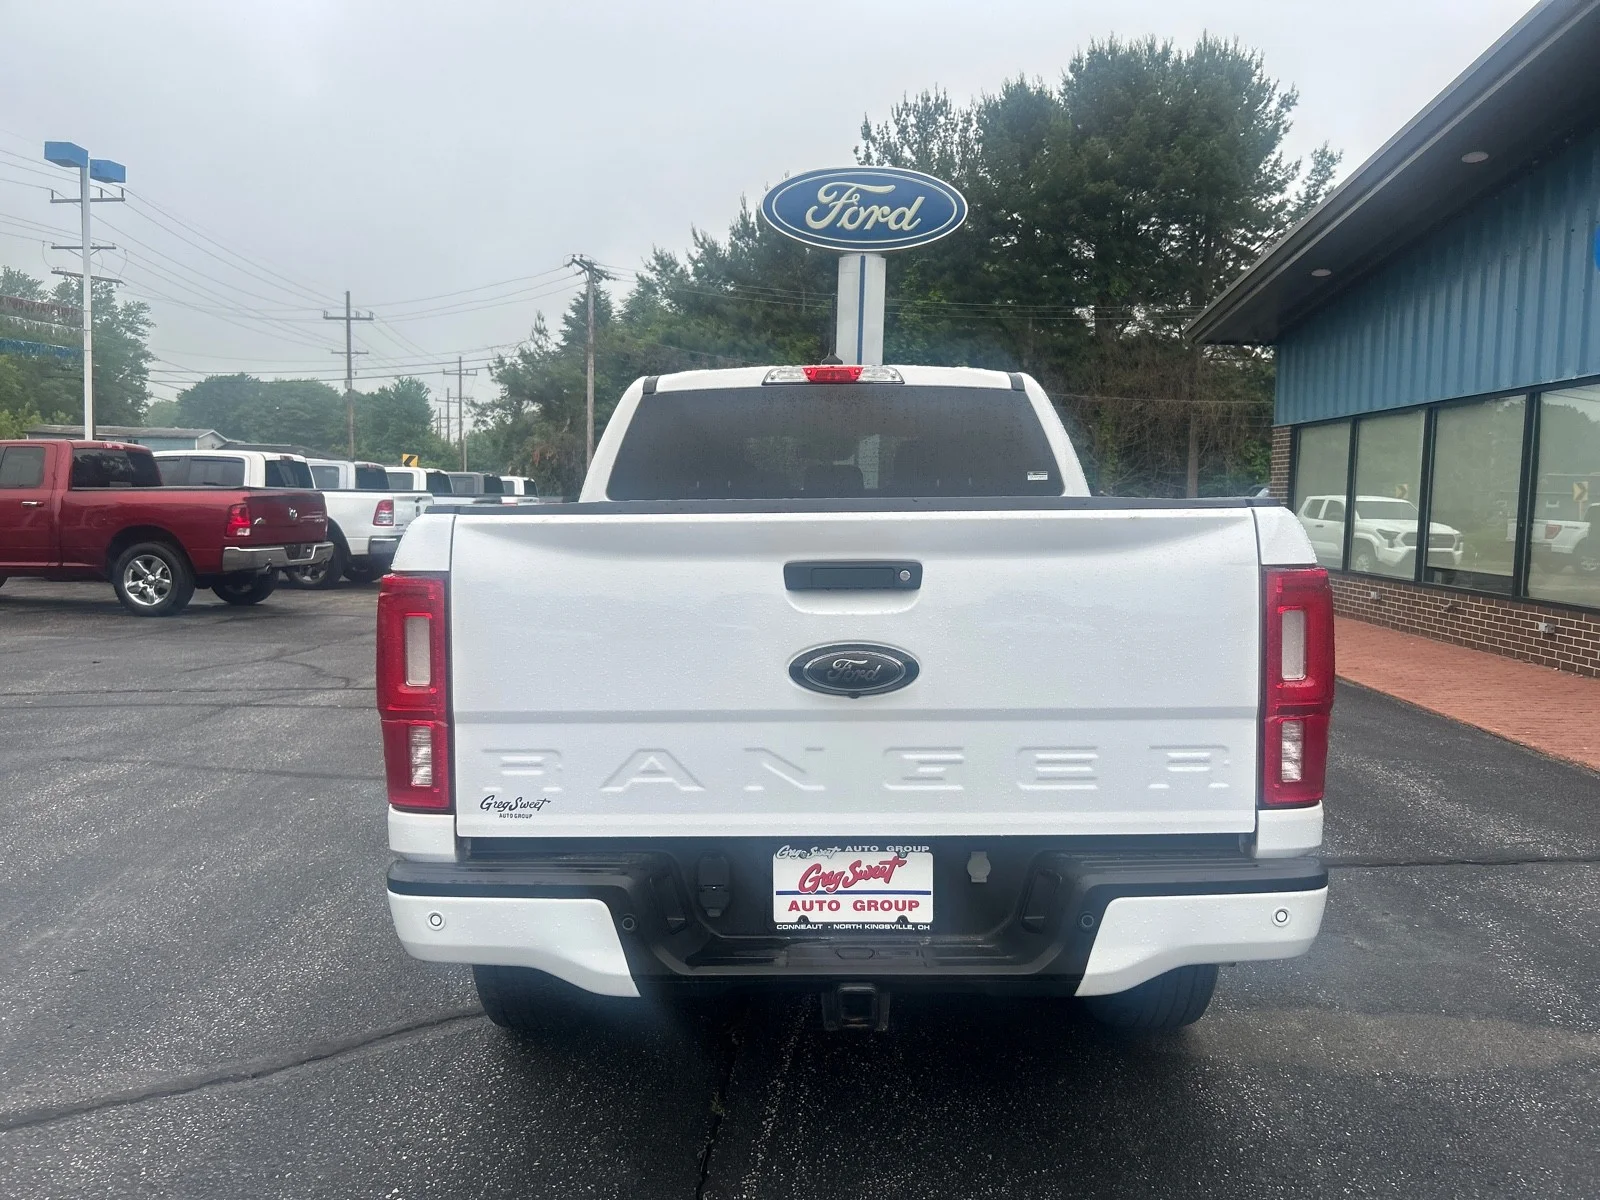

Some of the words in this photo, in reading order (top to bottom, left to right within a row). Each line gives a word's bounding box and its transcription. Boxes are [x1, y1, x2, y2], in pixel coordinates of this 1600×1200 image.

[805, 181, 926, 231] Ford
[827, 658, 881, 681] Ford
[482, 746, 1230, 793] RANGER
[480, 794, 511, 813] Greg
[508, 796, 552, 812] Sweet
[798, 862, 846, 894] Greg
[841, 855, 908, 889] Sweet
[788, 899, 841, 912] AUTO
[852, 899, 920, 912] GROUP
